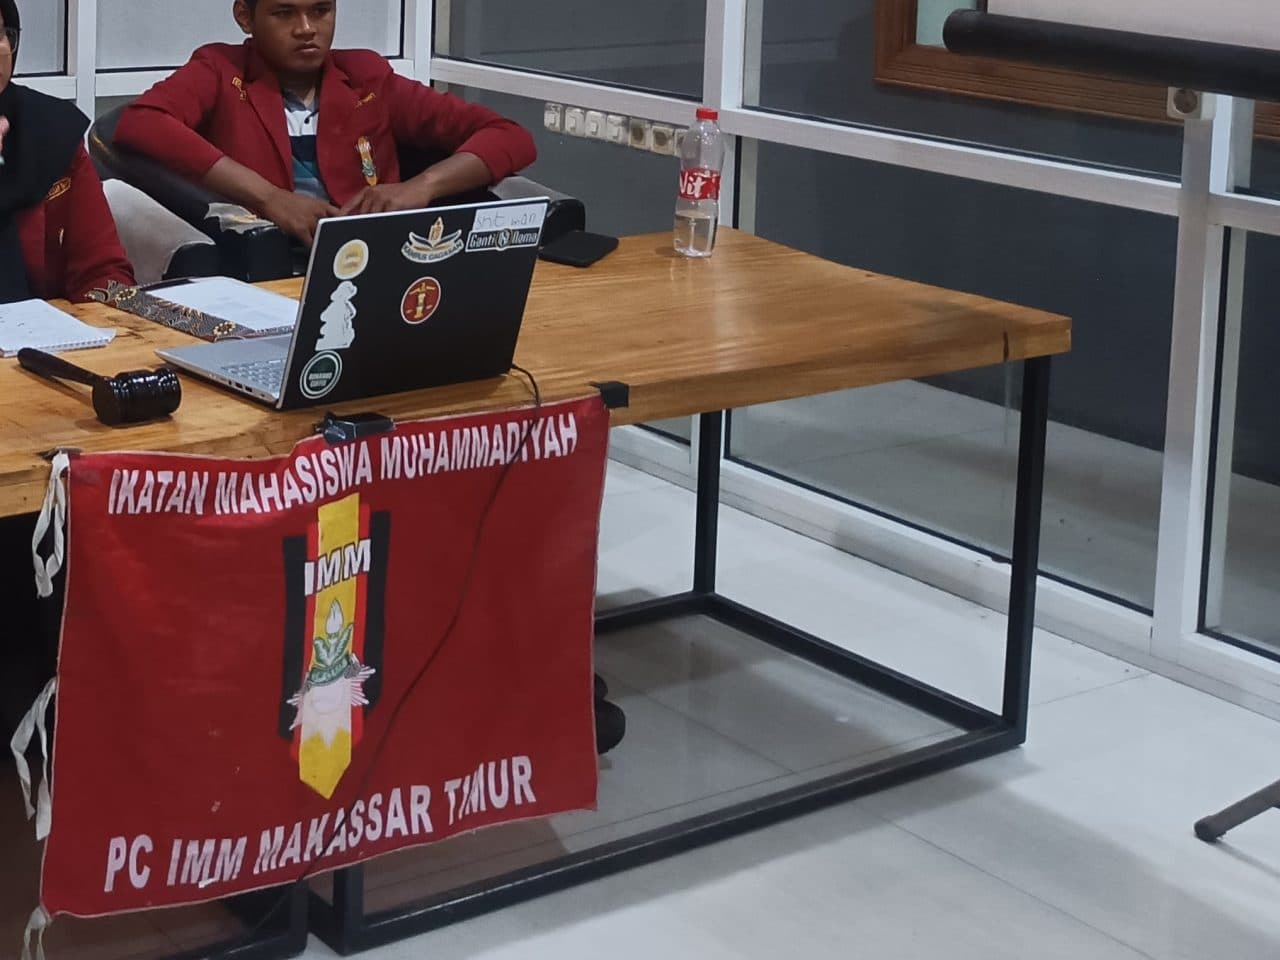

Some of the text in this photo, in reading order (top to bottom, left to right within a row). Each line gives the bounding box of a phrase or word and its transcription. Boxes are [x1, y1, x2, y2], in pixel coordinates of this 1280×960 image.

[107, 412, 578, 515] IKATAN MAHASISWA MUHAMMADIYAH
[304, 538, 372, 597] IMM
[104, 755, 538, 892] PC IMM MAKASSAR TIMUR
